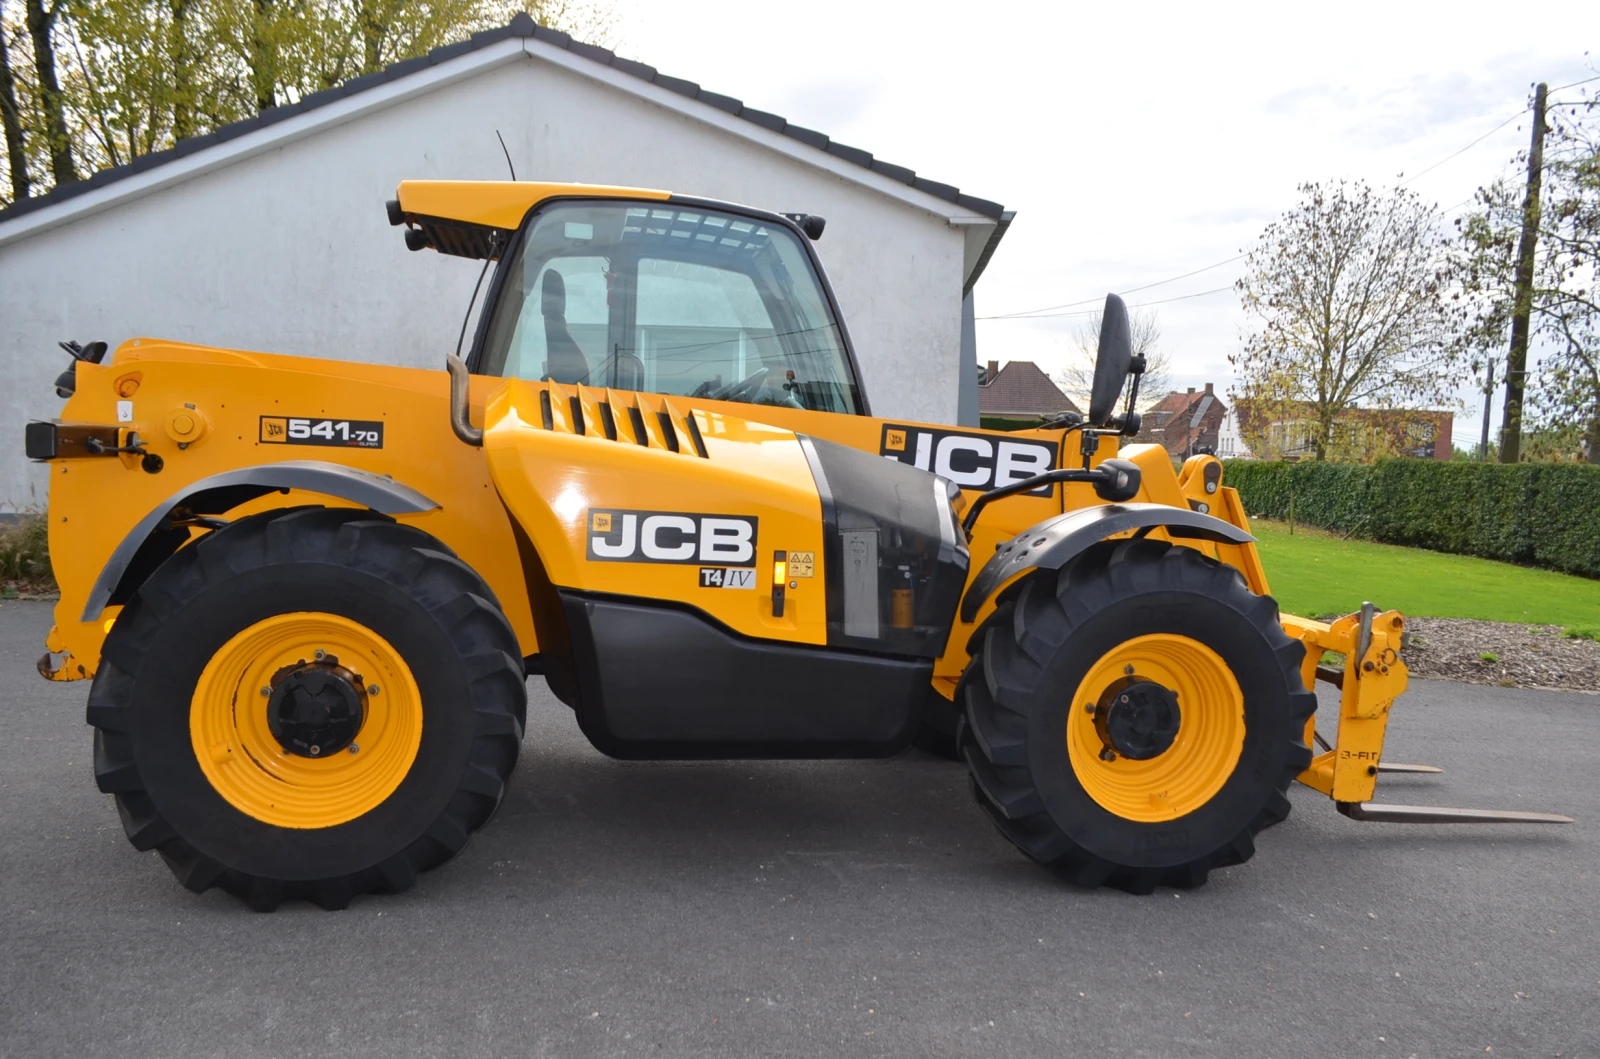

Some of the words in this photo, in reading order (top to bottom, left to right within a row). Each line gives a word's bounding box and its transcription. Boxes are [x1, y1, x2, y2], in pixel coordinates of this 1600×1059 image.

[288, 419, 378, 442] 541-70
[884, 432, 1051, 492] JCB
[592, 514, 753, 562] JCB
[701, 569, 722, 586] T4
[727, 570, 753, 586] IV
